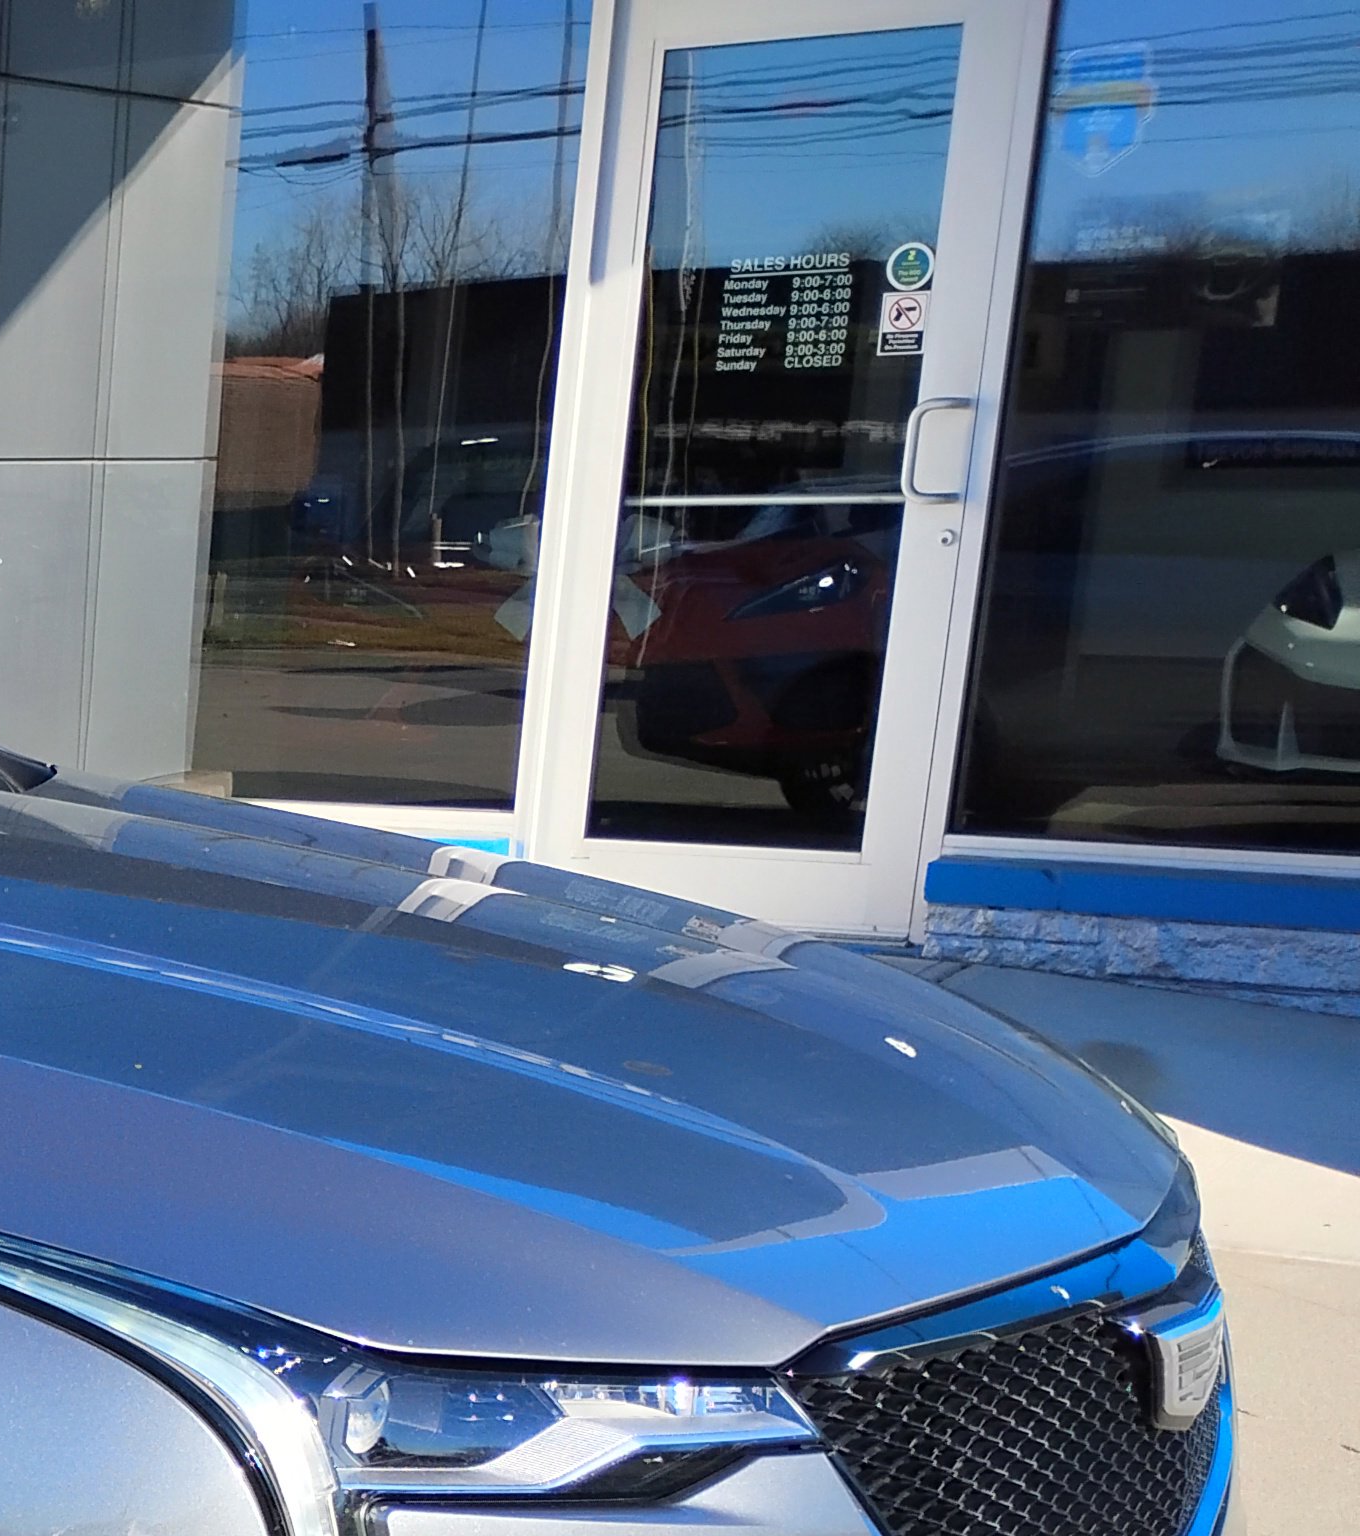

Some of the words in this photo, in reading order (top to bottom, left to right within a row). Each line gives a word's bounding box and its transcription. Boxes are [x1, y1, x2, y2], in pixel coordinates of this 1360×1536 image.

[730, 256, 785, 272] SALES
[790, 253, 850, 269] HOURS
[724, 279, 769, 291] Monday
[792, 274, 852, 288] 9:00-7:00
[723, 293, 768, 305] Tuesday
[791, 288, 851, 302] 9:00-6:00
[721, 305, 786, 317] Wednesday
[790, 302, 850, 316] 9:00-6:00
[720, 319, 771, 331] Thursday
[788, 315, 849, 329] 9:00-7:00
[718, 333, 753, 345] Friday
[787, 329, 847, 343] 9:00-6:00
[717, 347, 766, 358] Saturday
[785, 343, 845, 356] 9:00-3:00
[715, 360, 757, 372] Sunday
[784, 355, 842, 368] CLOSED
